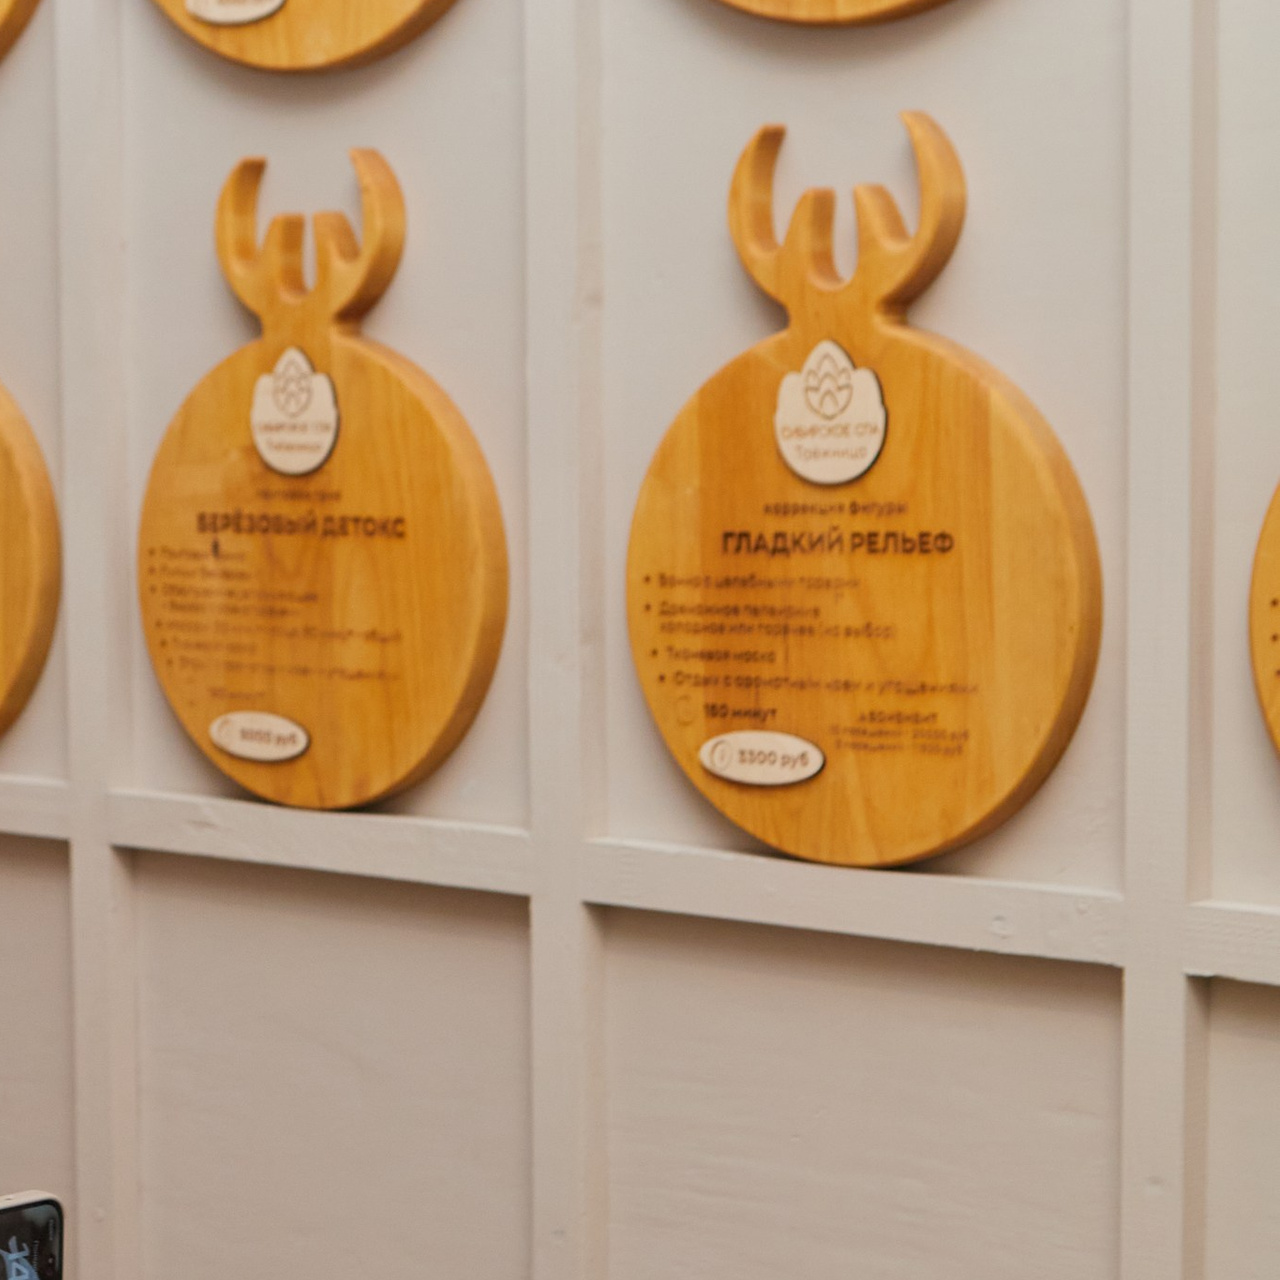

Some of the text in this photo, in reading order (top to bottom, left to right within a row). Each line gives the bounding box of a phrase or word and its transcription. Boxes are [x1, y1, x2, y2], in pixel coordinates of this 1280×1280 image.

[722, 526, 956, 558] ГЛАДКИЙ РЕЛЬЕФ
[780, 751, 810, 769] руб
